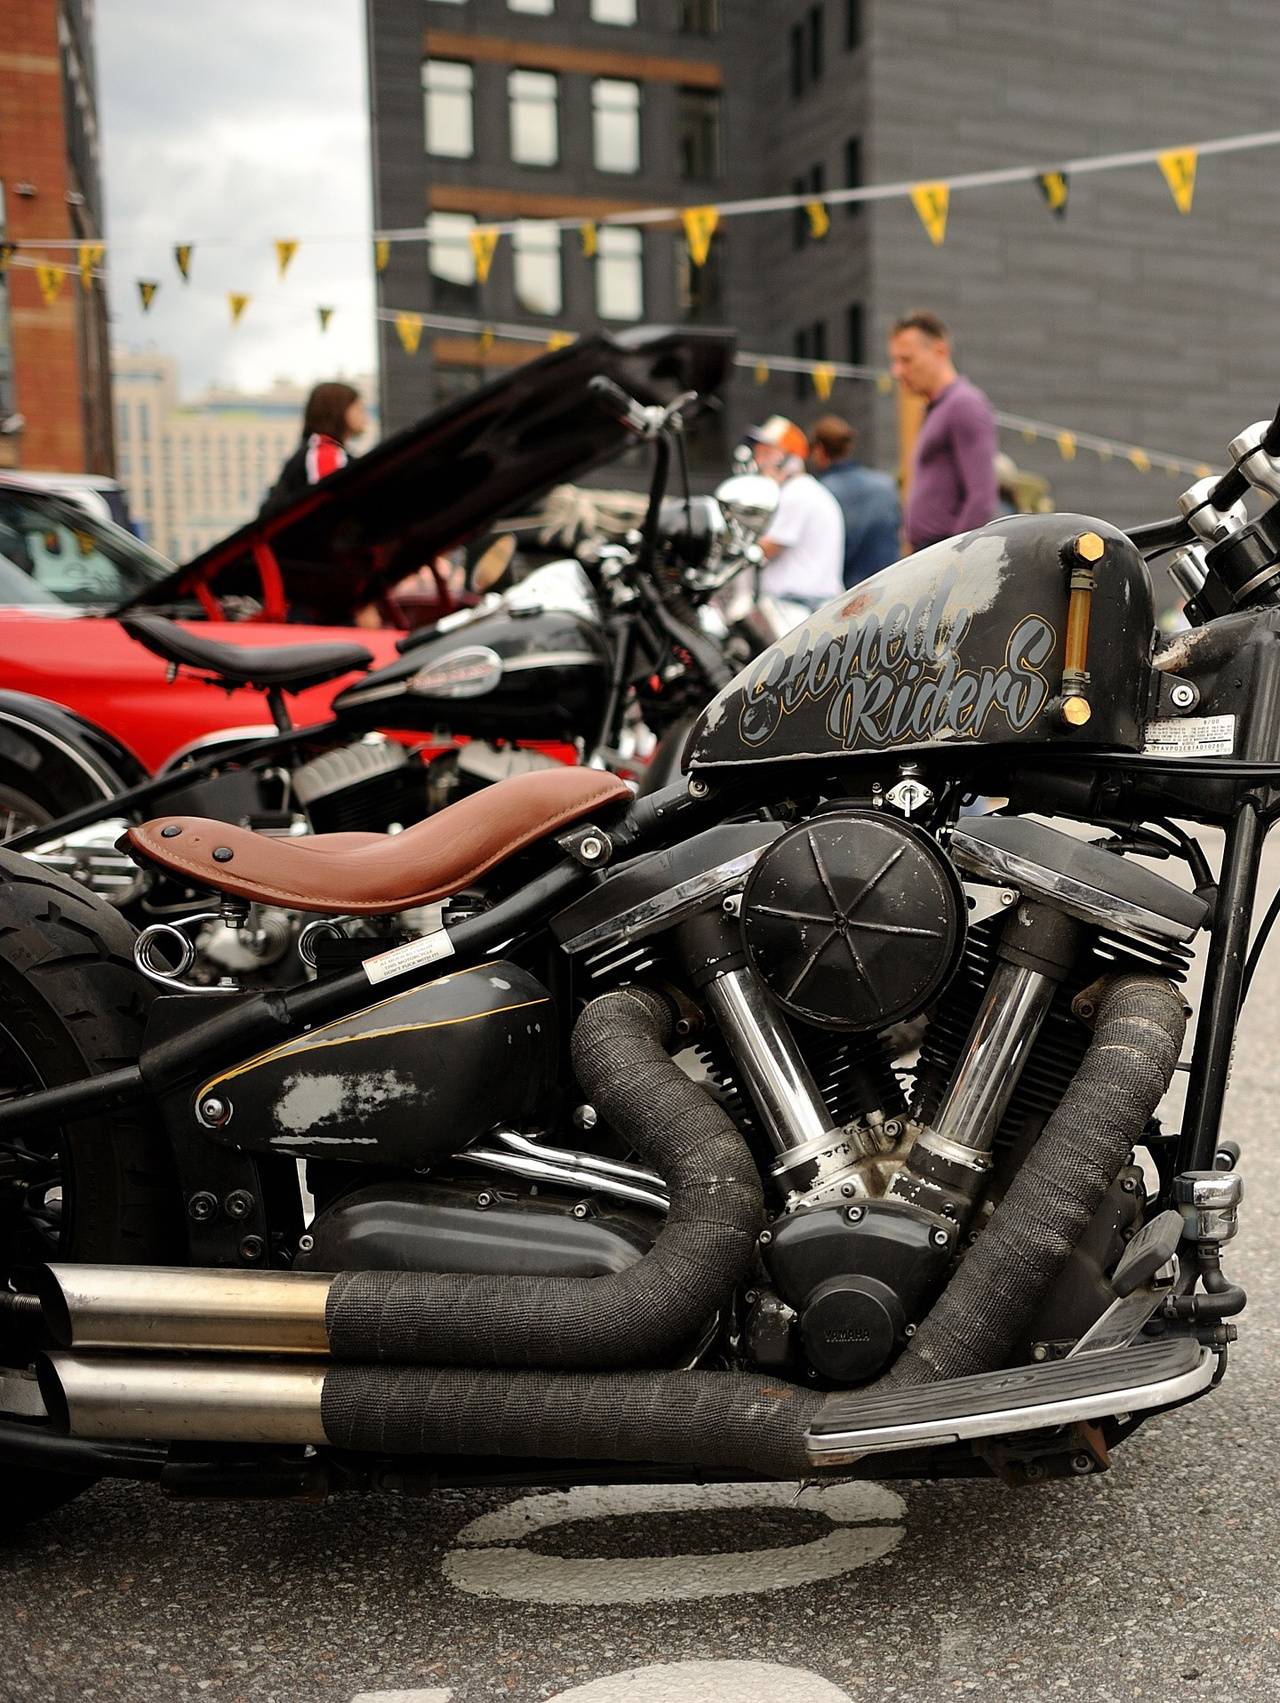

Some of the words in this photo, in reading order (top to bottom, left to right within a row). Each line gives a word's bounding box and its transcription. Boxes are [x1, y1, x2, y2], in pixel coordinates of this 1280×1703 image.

[741, 559, 972, 745] Stoned
[388, 954, 404, 963] MUCH
[398, 949, 432, 964] MOTORCYCLE
[384, 966, 400, 975] DON'T
[417, 955, 431, 963] WITH
[824, 1328, 871, 1343] YAMAHA
